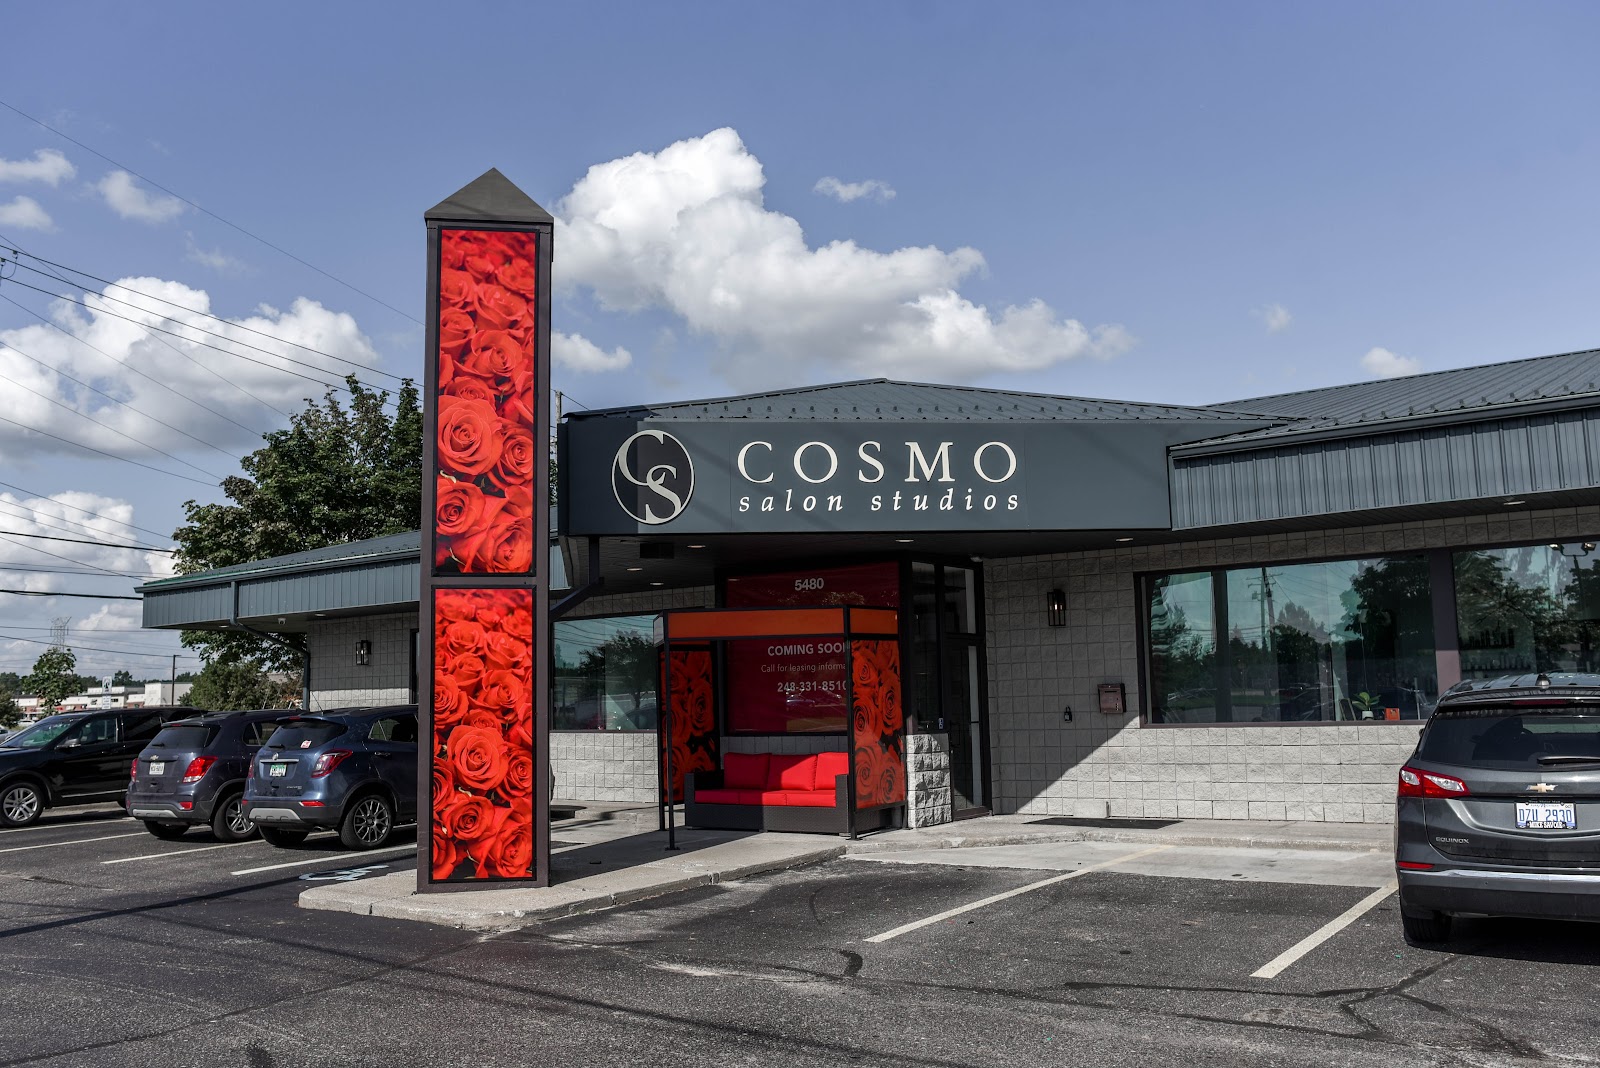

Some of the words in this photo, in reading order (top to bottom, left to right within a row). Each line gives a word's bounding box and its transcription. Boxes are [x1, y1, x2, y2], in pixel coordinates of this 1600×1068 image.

[737, 441, 1018, 484] COSMO
[738, 488, 844, 512] salon
[870, 487, 1019, 512] studios
[794, 577, 824, 591] 5480
[767, 643, 814, 657] COMING
[760, 664, 775, 673] Call
[777, 664, 787, 672] for
[789, 663, 816, 673] leasing
[818, 661, 846, 671] informa
[1545, 809, 1573, 823] 2930
[1435, 836, 1470, 844] EQUINOX
